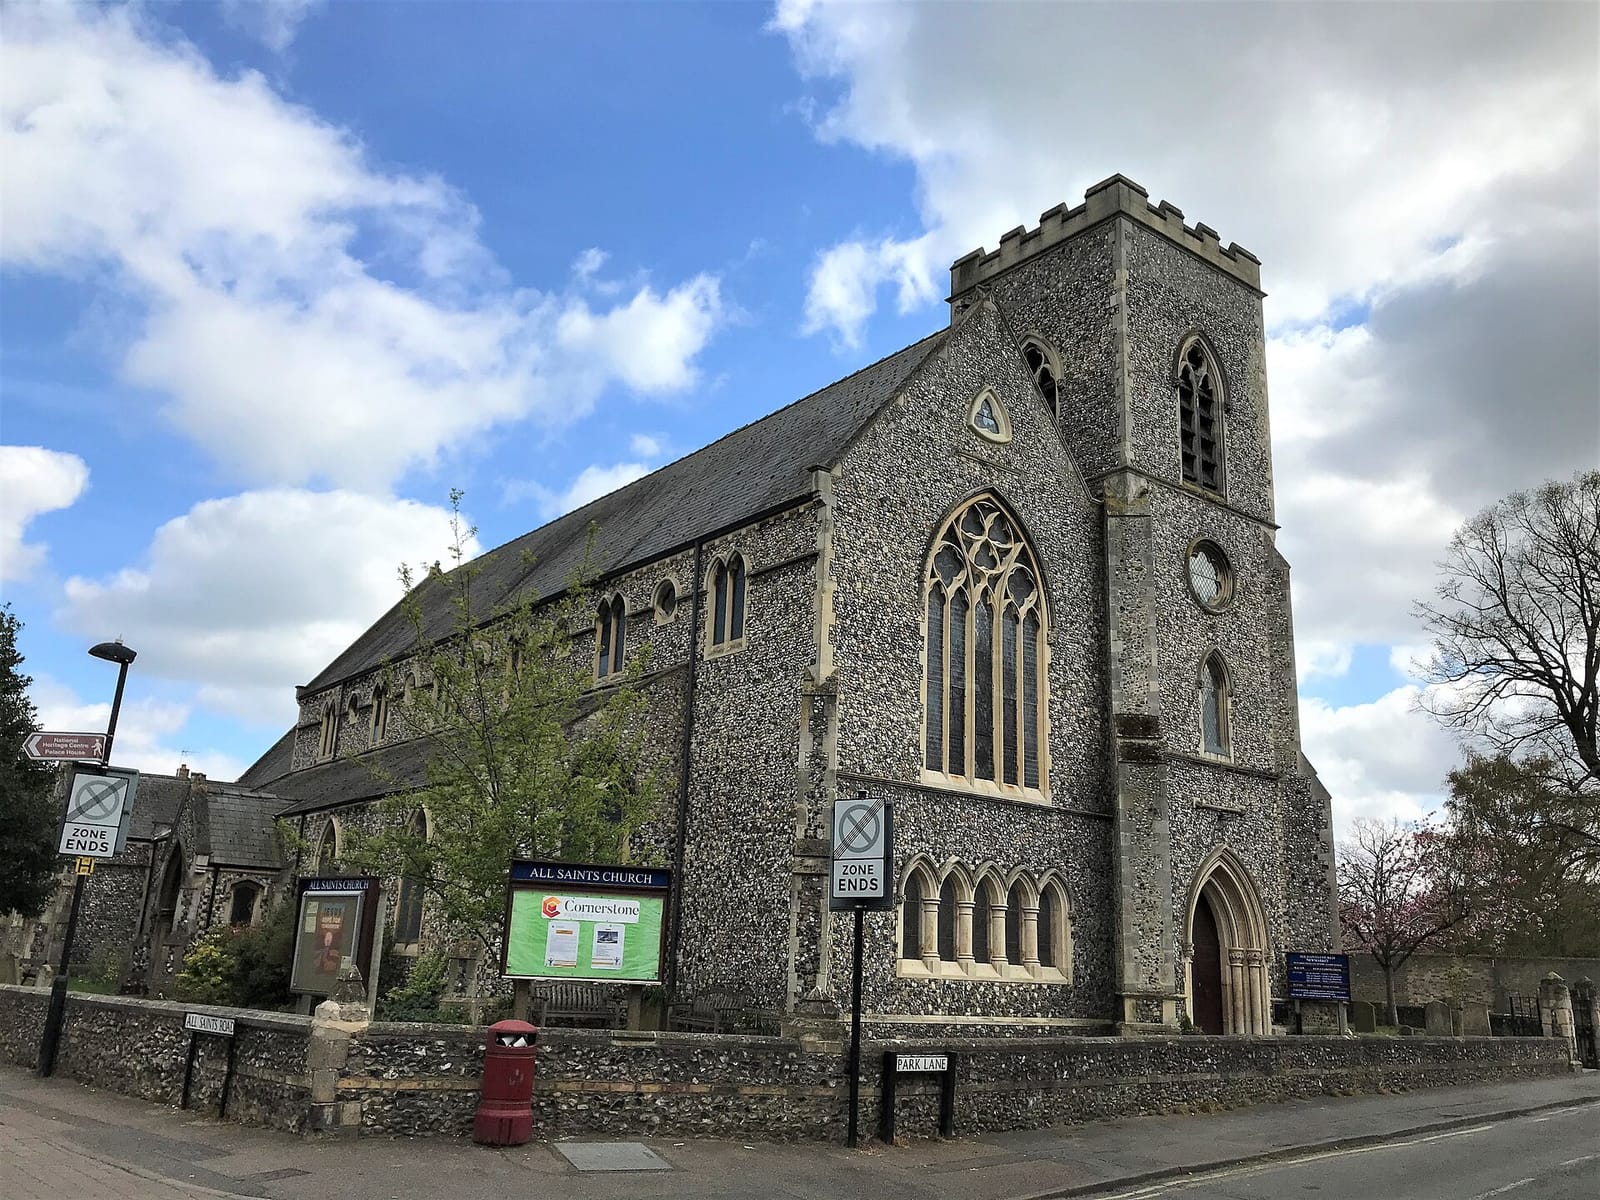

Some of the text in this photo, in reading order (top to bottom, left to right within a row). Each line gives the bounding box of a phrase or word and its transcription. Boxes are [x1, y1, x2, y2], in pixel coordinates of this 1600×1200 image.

[72, 828, 107, 840] ZONE
[65, 838, 109, 853] ENDS
[78, 858, 92, 873] H
[842, 864, 874, 875] ZONE
[530, 867, 652, 884] ALL SAINTS CHURCH
[308, 880, 369, 890] ALL SAINTS CHURCH
[838, 878, 878, 891] ENDS
[564, 899, 640, 916] Cornerstone
[186, 1015, 234, 1033] ALL SAINTS ROAD
[897, 1058, 946, 1070] PARK LANE
